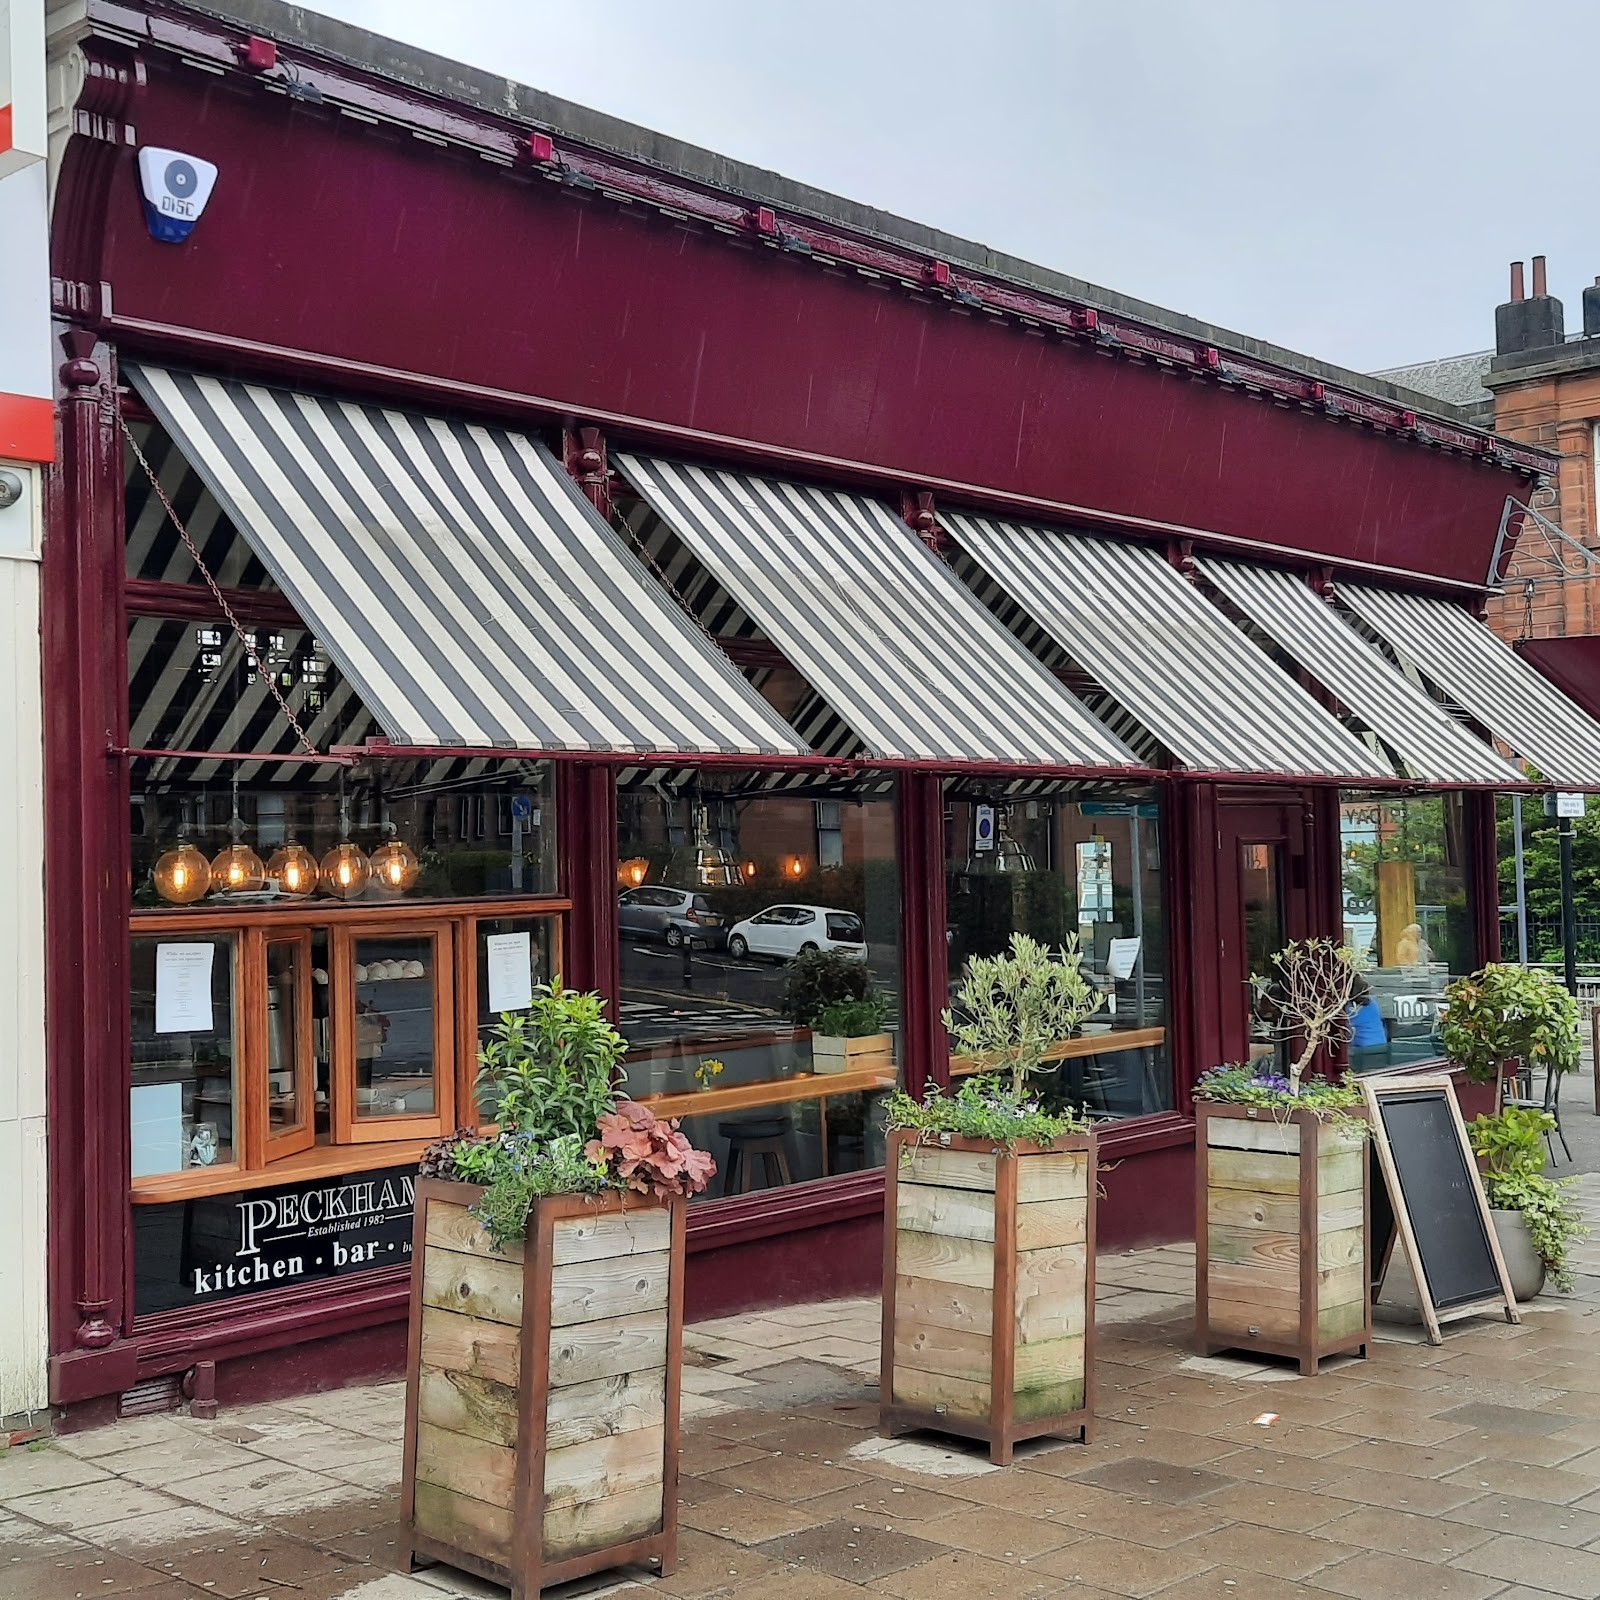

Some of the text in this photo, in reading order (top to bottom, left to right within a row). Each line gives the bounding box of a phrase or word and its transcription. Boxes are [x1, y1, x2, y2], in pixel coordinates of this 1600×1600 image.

[161, 196, 195, 217] DISC
[307, 1214, 385, 1238] Established 1982
[193, 1255, 304, 1295] kitchen
[333, 1240, 379, 1268] bar
